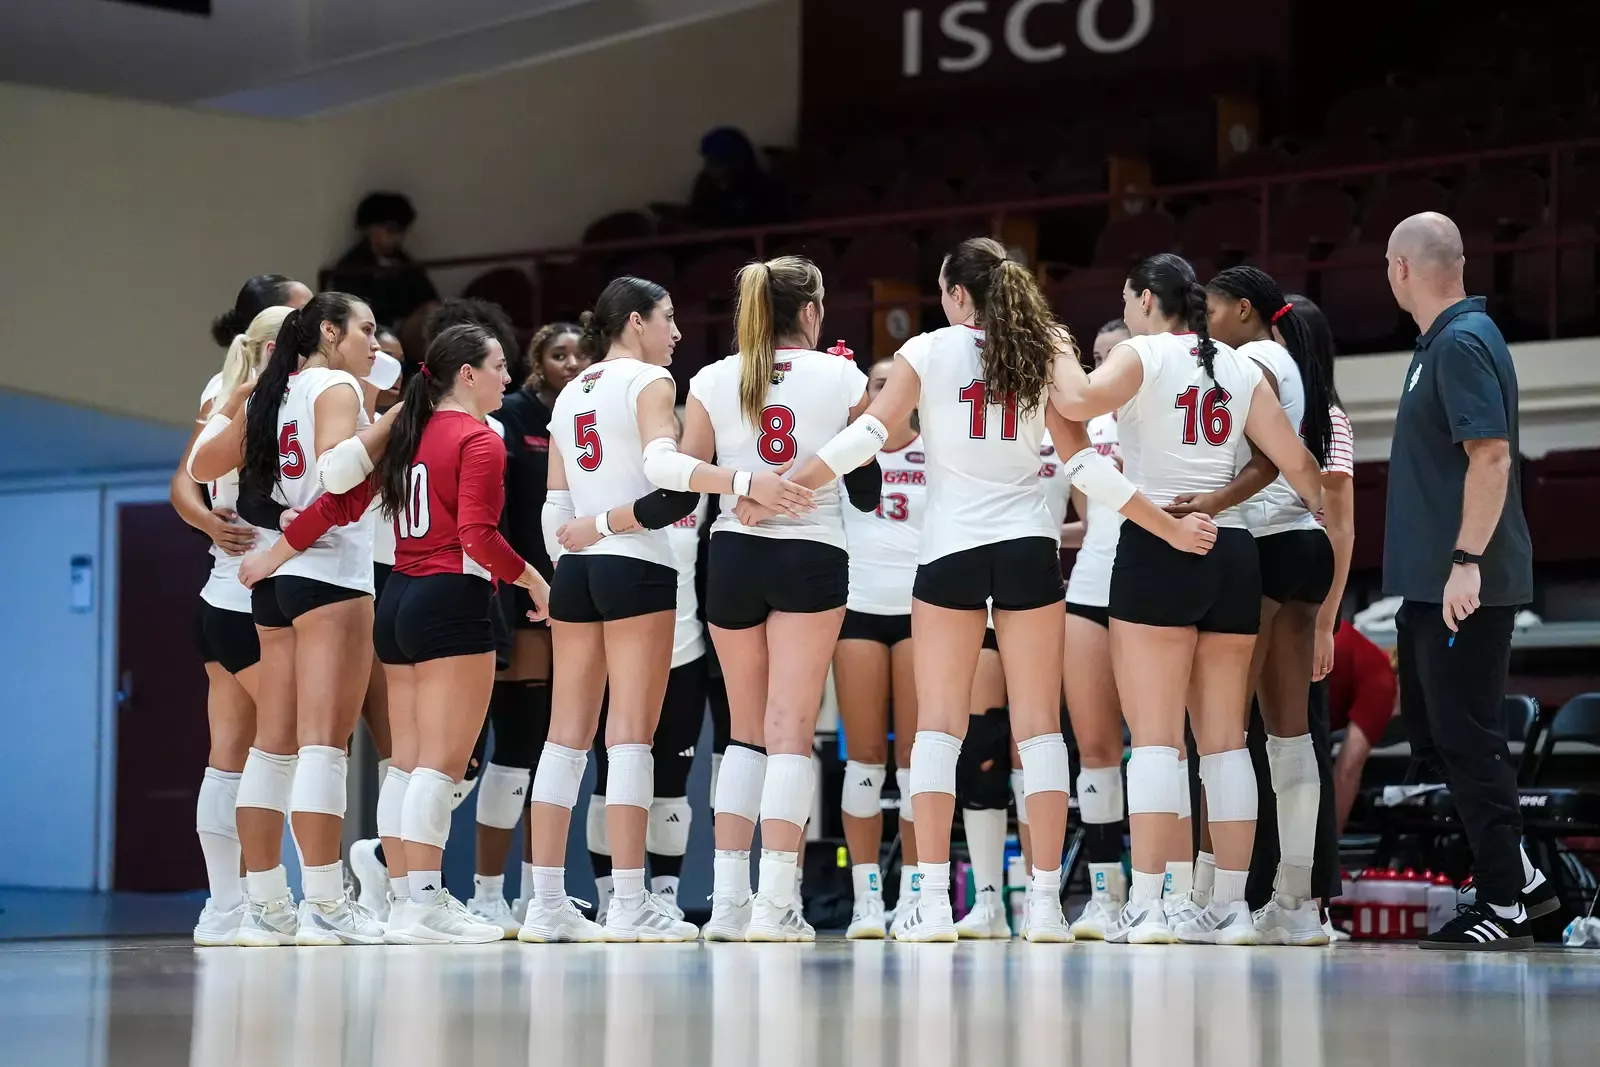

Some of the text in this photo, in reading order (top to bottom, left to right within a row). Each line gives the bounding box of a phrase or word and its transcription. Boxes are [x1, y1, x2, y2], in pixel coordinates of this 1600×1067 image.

[902, 0, 1155, 77] ISCO
[574, 410, 603, 472] 5
[757, 404, 797, 465] 8
[959, 379, 1018, 441] 11
[1175, 386, 1233, 447] 16
